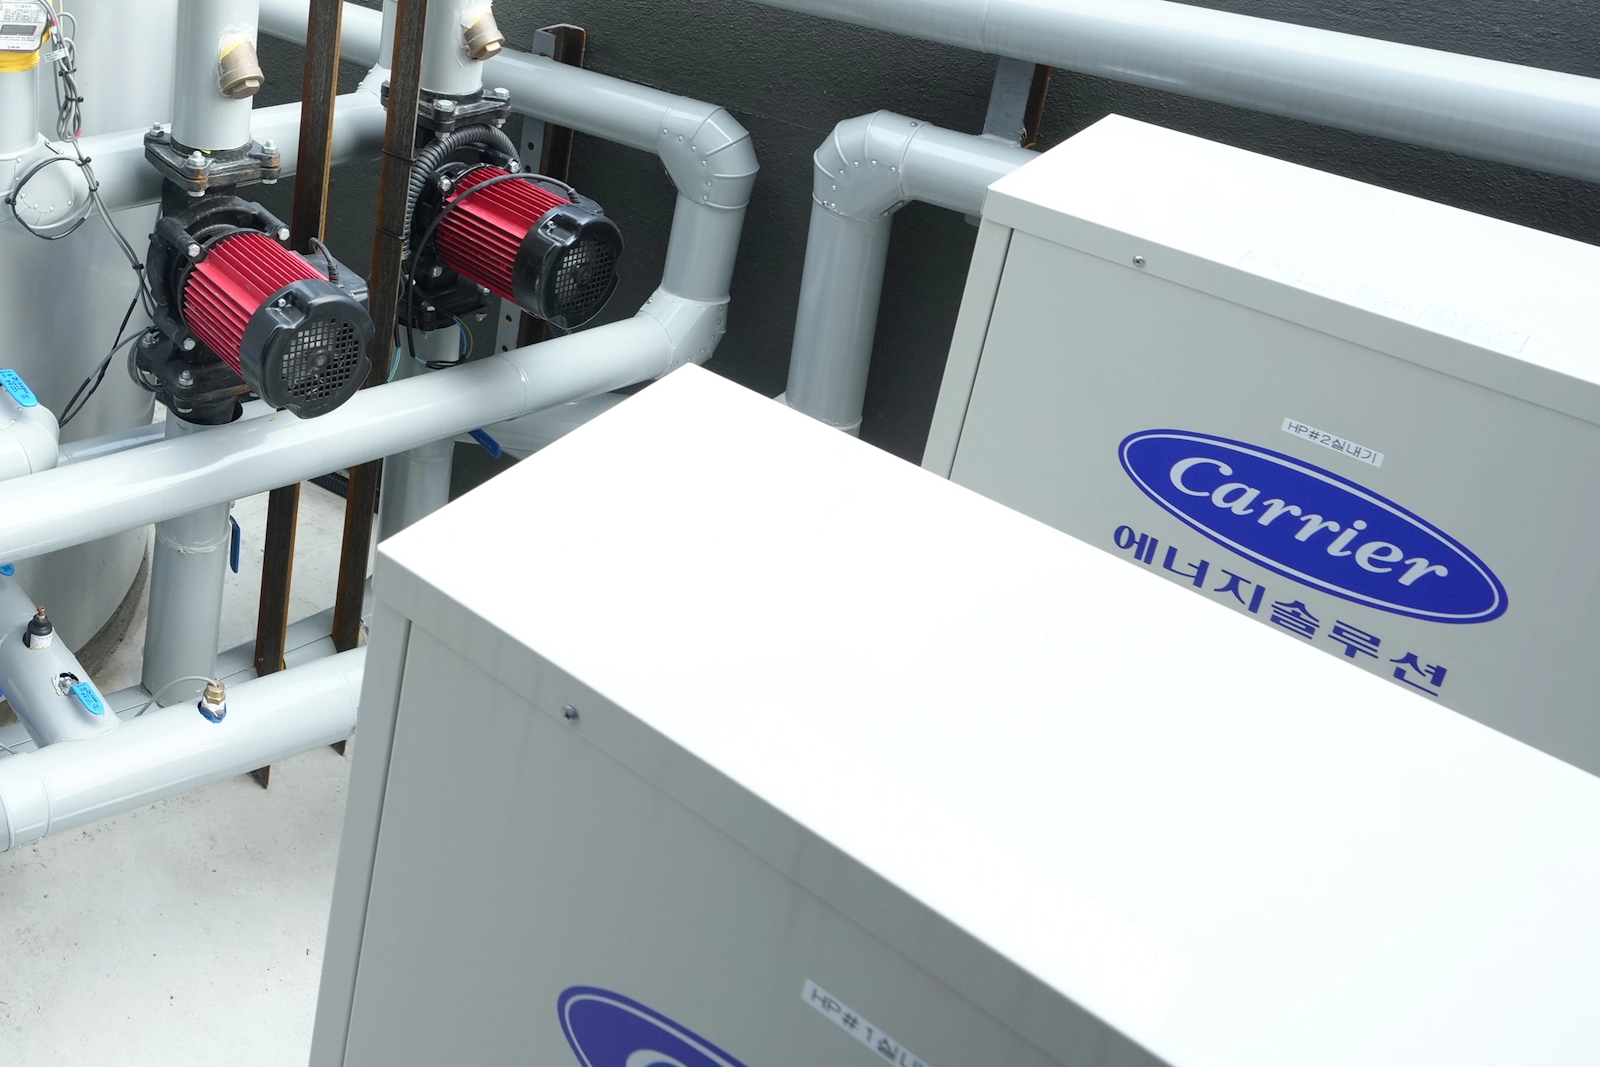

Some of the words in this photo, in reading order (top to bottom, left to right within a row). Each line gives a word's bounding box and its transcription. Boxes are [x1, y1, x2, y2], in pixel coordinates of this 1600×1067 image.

[1287, 421, 1378, 464] HP#2실내기
[1169, 457, 1449, 587] Carrier
[1113, 525, 1448, 697] 에너지솔루션
